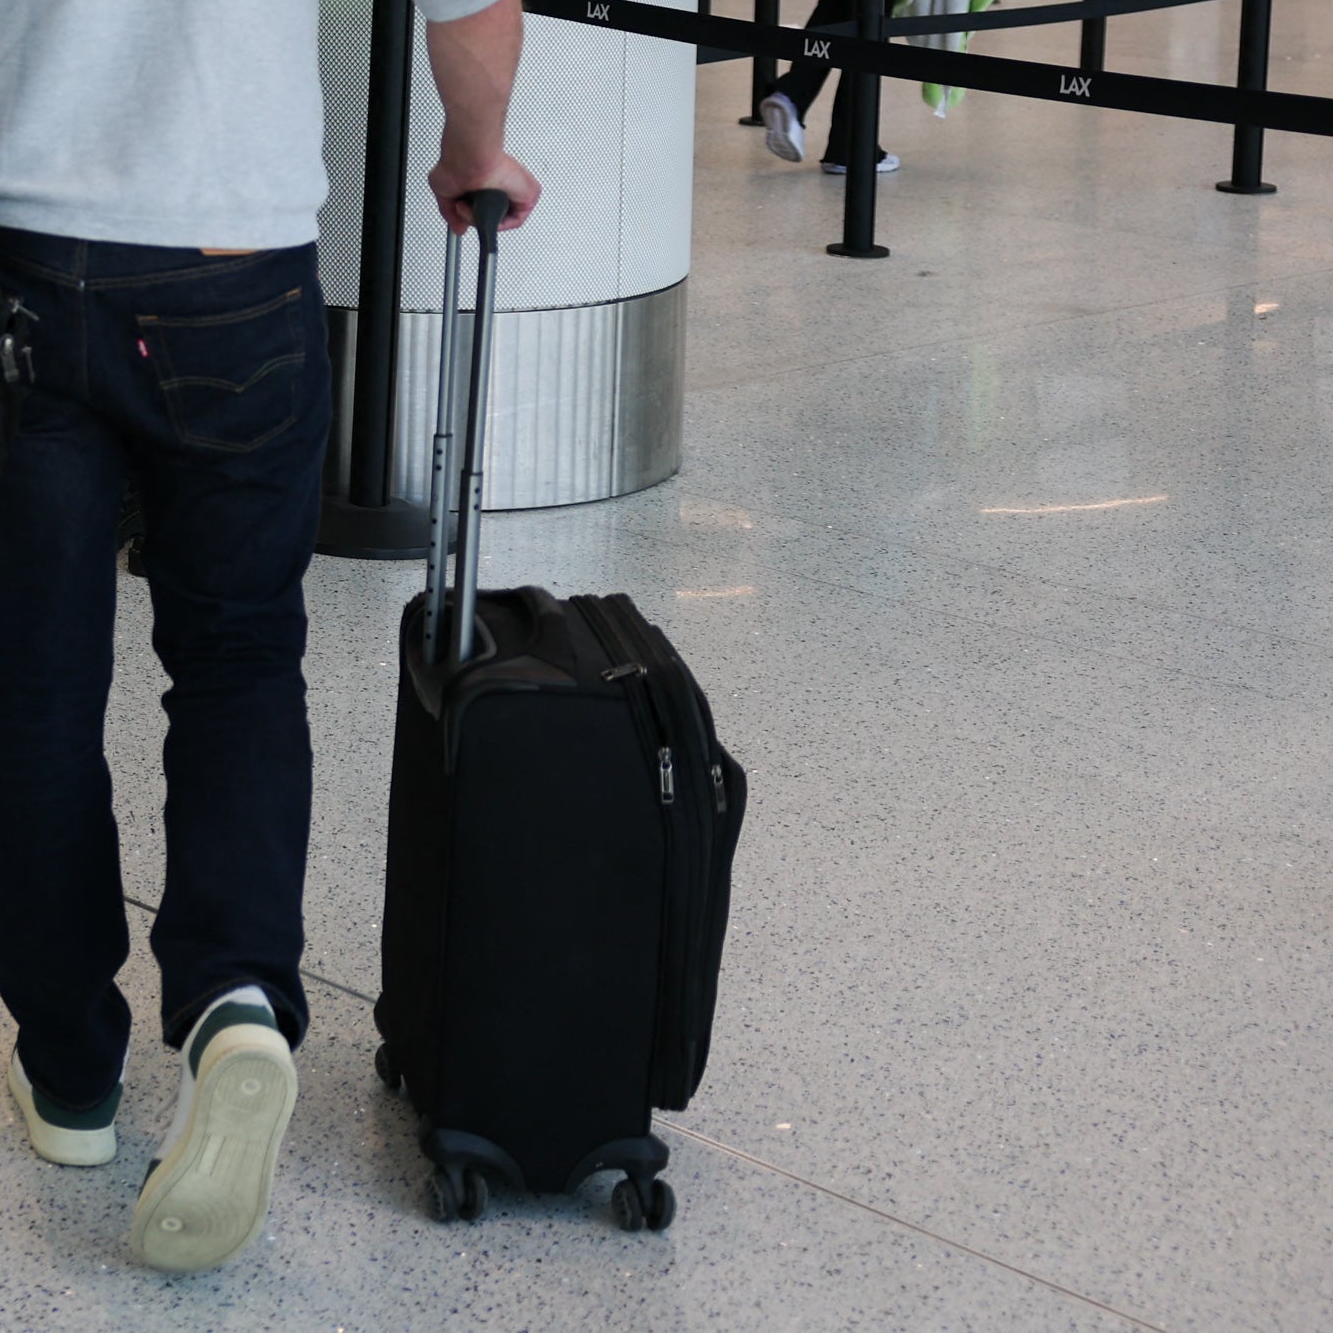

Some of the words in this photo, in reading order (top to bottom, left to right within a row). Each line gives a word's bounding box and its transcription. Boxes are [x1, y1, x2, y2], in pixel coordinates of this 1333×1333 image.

[587, 1, 610, 21] LAX
[804, 38, 831, 60] LAX
[1059, 74, 1092, 98] LAX
